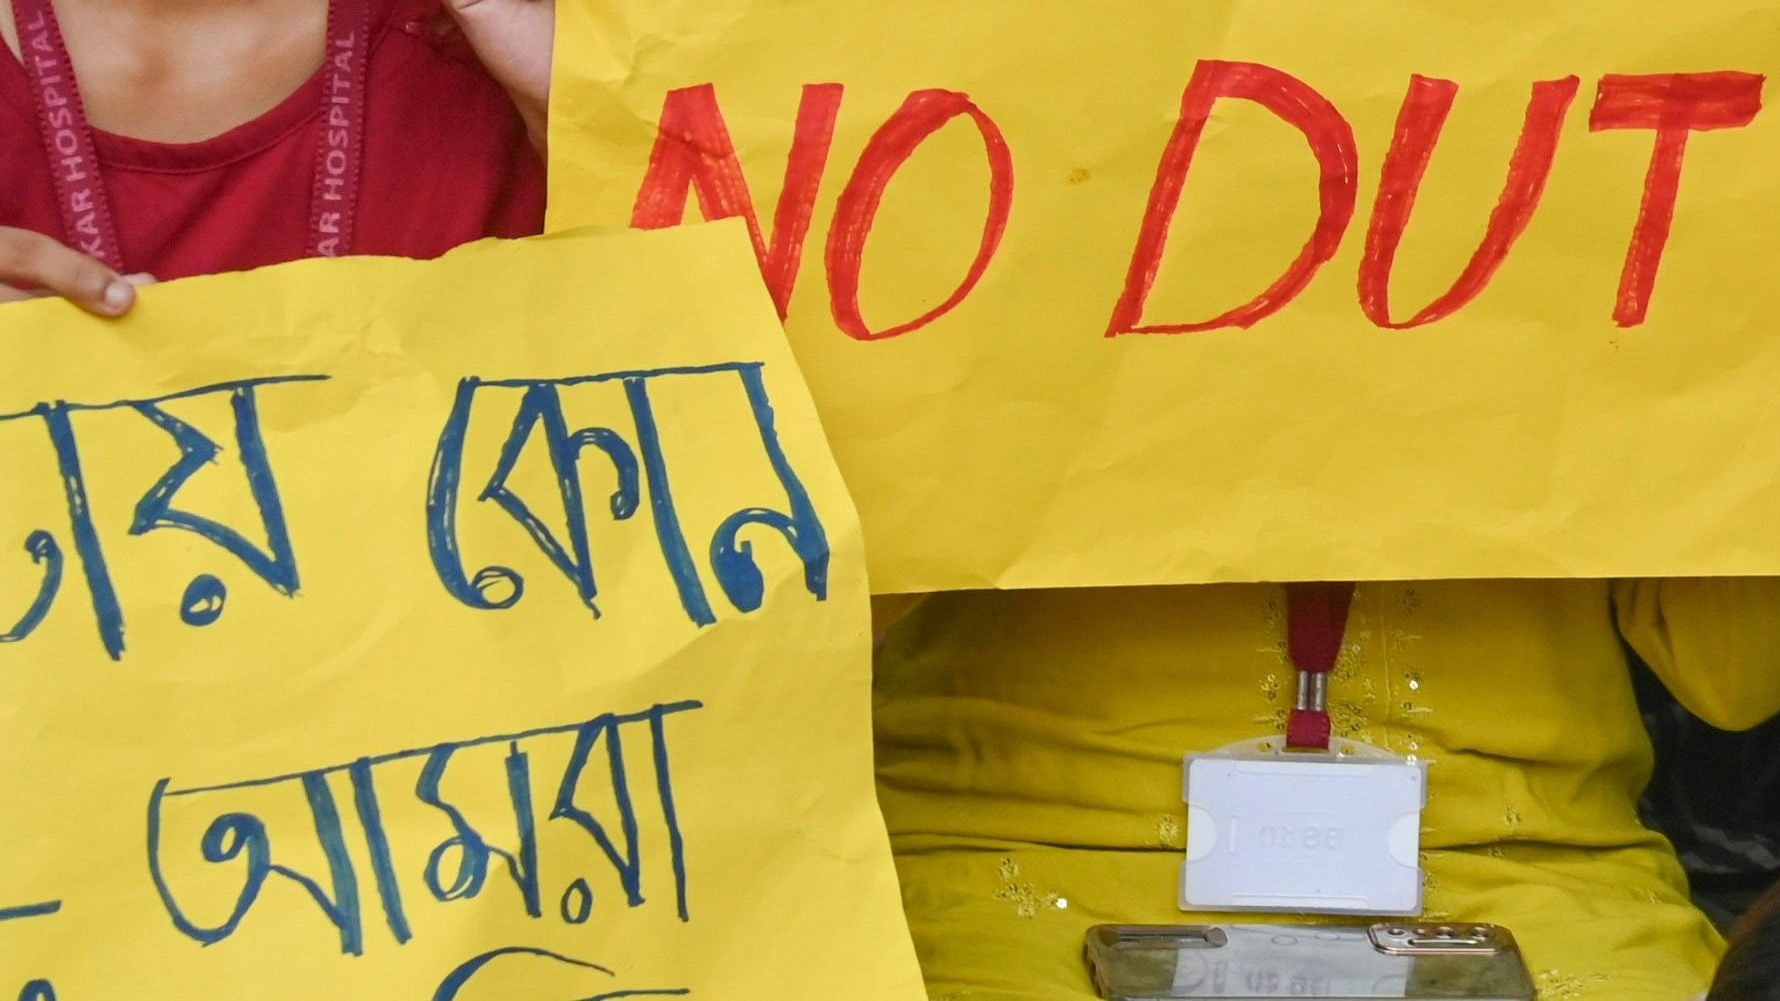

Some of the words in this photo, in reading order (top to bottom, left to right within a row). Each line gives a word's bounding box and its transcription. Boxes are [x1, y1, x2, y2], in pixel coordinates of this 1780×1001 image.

[27, 10, 86, 182] HOSPITAL
[322, 31, 355, 200] HOSPITAL
[632, 82, 1013, 341] NO
[425, 362, 830, 630] কোন
[147, 700, 703, 956] আমরা
